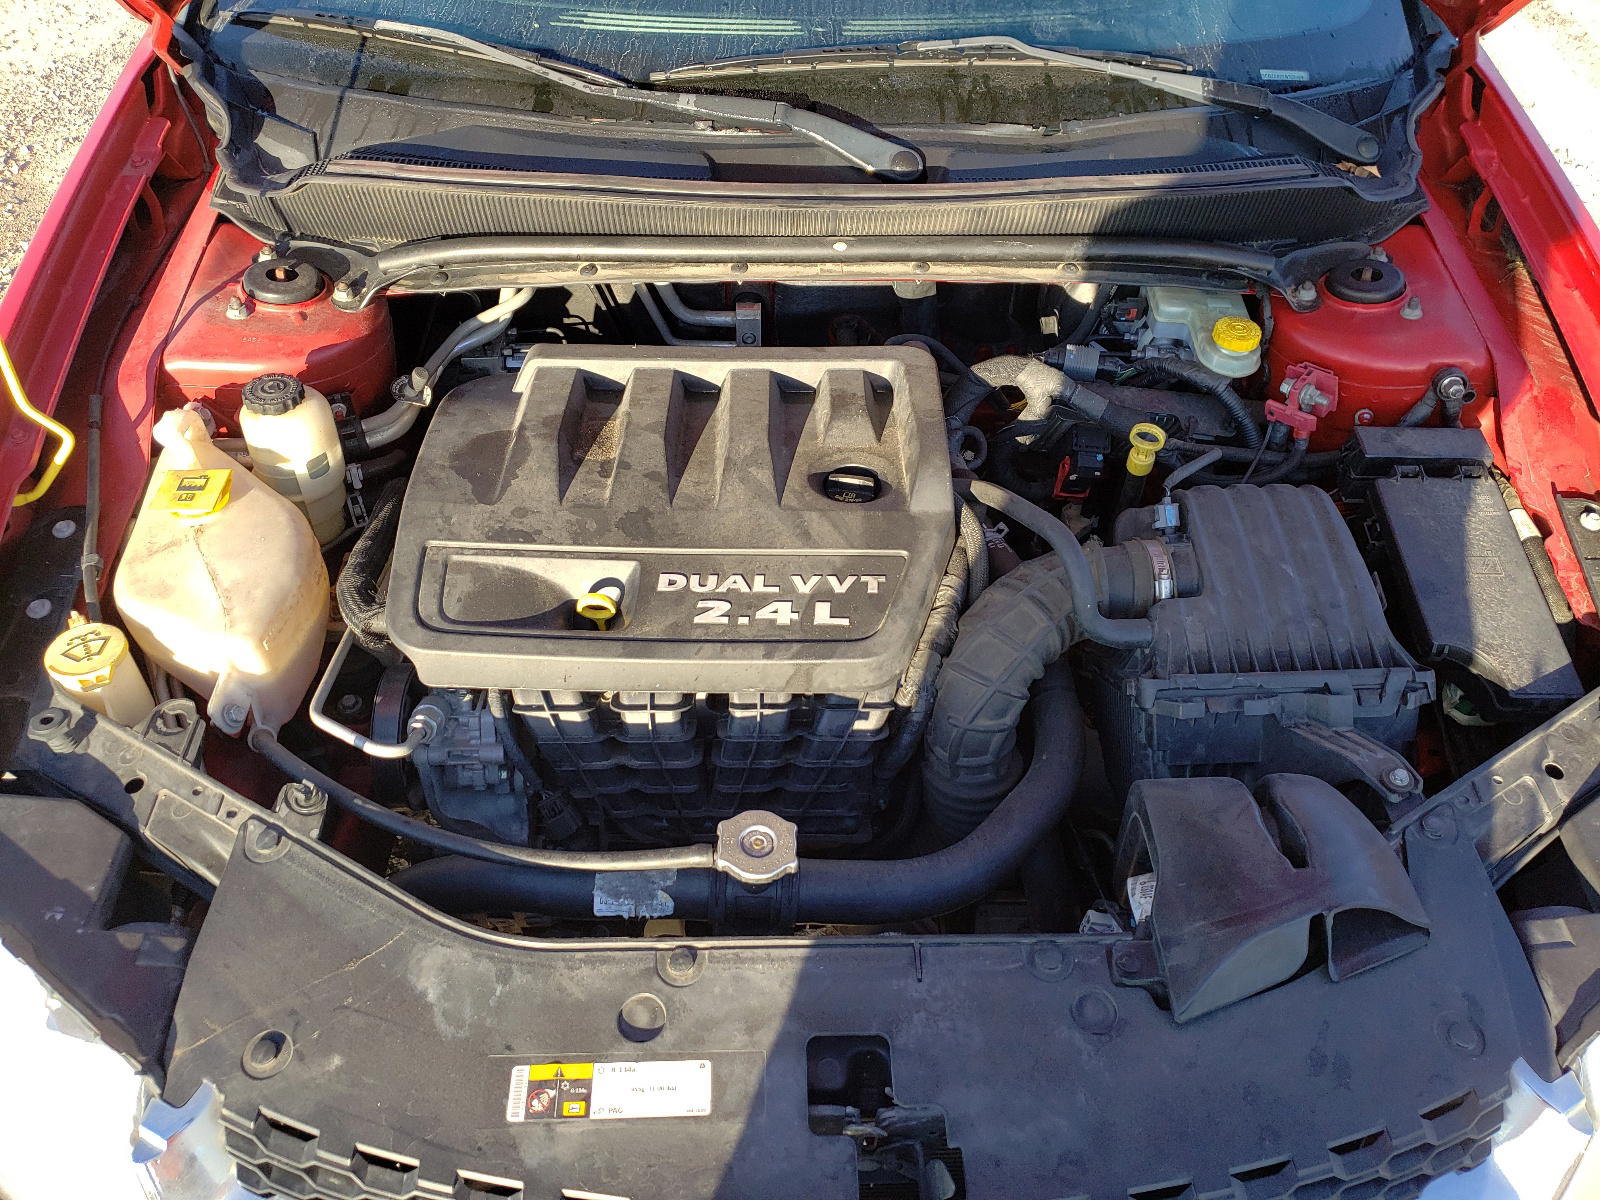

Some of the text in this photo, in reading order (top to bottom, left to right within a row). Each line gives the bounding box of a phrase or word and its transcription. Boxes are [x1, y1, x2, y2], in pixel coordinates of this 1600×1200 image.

[656, 573, 886, 594] DUAL VVT
[693, 599, 850, 626] 2.4 L
